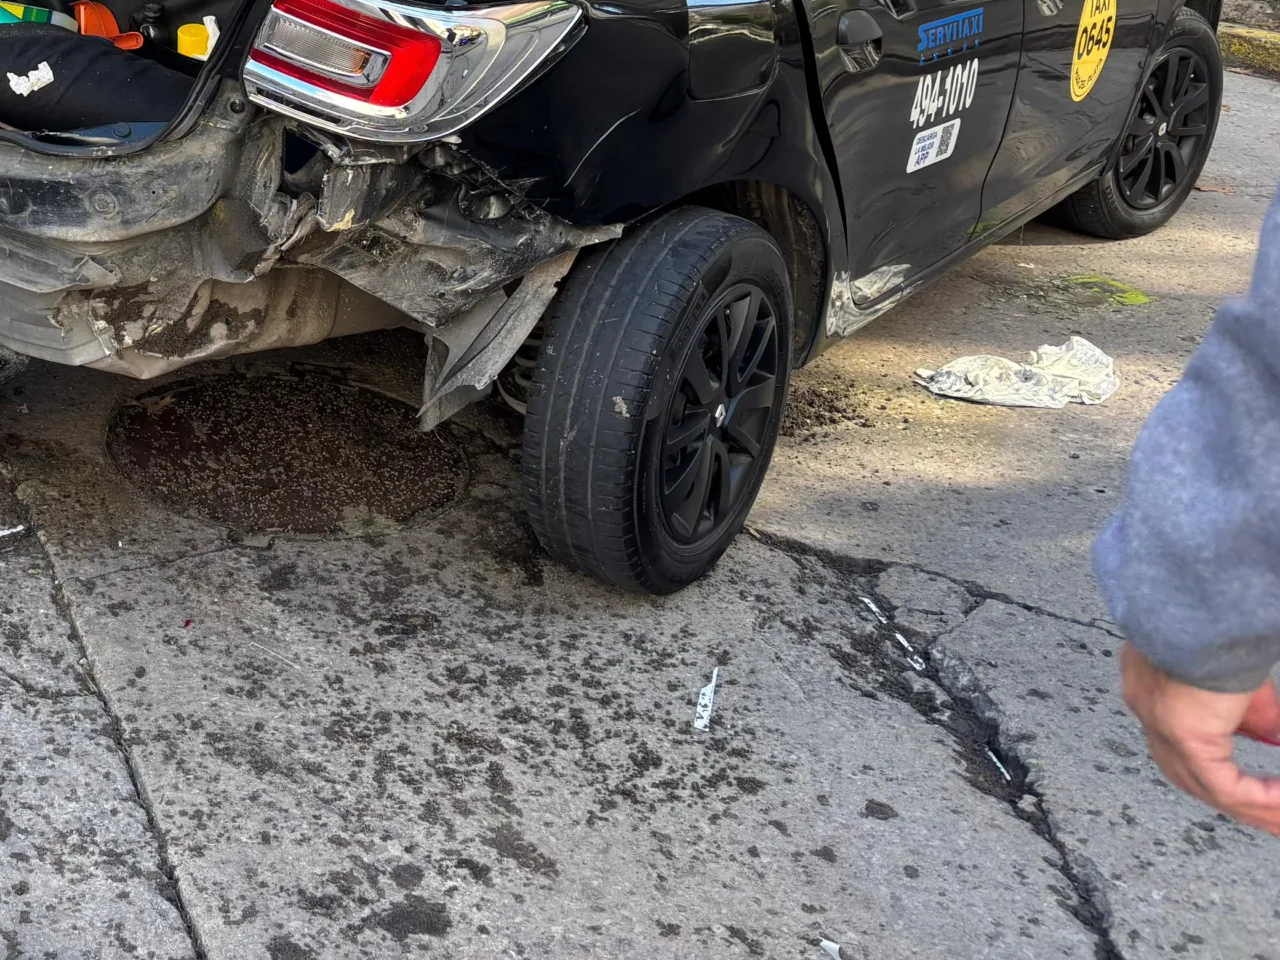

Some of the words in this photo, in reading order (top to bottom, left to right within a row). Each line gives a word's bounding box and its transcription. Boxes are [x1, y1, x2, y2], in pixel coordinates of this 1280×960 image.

[1077, 15, 1112, 60] 0645
[910, 58, 979, 129] 494-1010
[916, 131, 937, 145] DESCARGA
[914, 151, 930, 167] APP
